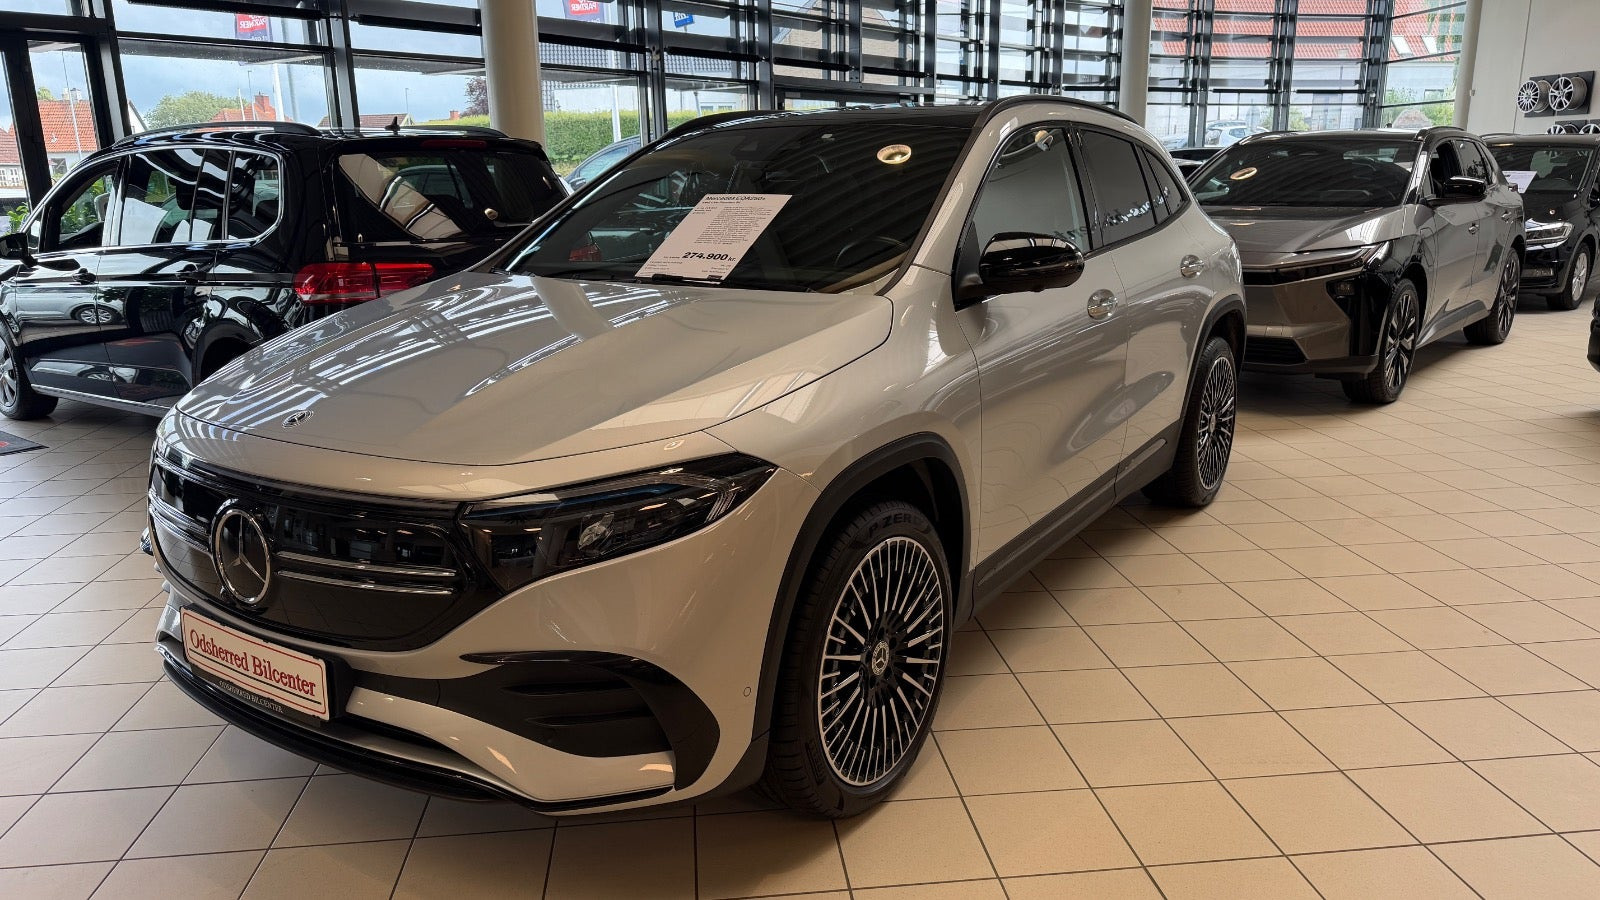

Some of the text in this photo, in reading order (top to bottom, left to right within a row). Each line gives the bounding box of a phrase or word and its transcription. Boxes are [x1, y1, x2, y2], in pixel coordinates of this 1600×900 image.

[682, 251, 729, 262] 274.900
[868, 521, 879, 538] P
[189, 628, 317, 697] Odsherred Bilcenter
